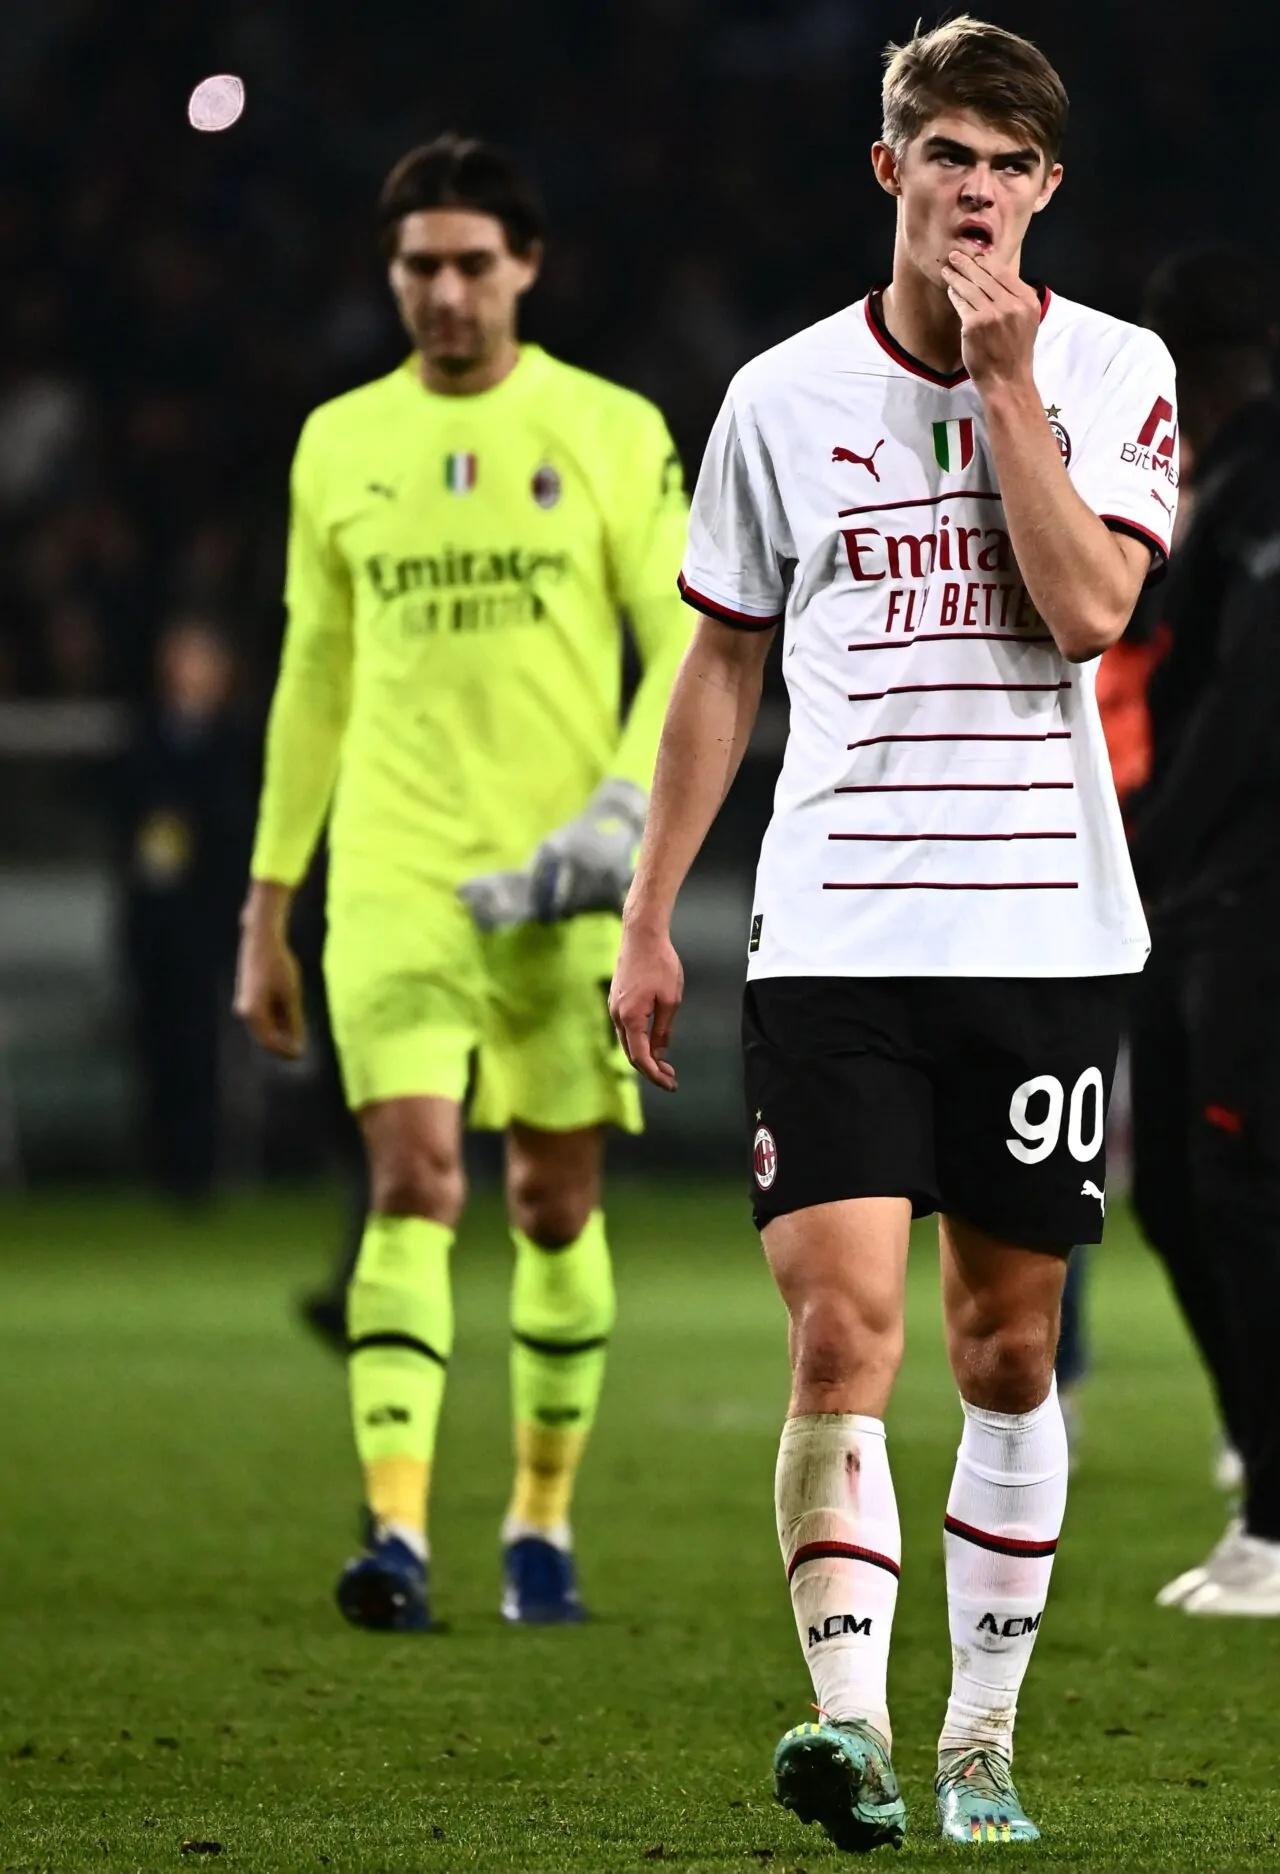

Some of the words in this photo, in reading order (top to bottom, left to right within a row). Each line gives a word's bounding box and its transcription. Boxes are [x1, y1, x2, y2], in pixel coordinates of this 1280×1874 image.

[840, 515, 1009, 582] Emira
[940, 583, 1049, 628] BETTE
[1006, 1066, 1104, 1165] 90
[808, 1613, 872, 1648] ACM
[976, 1612, 1043, 1638] ACM
